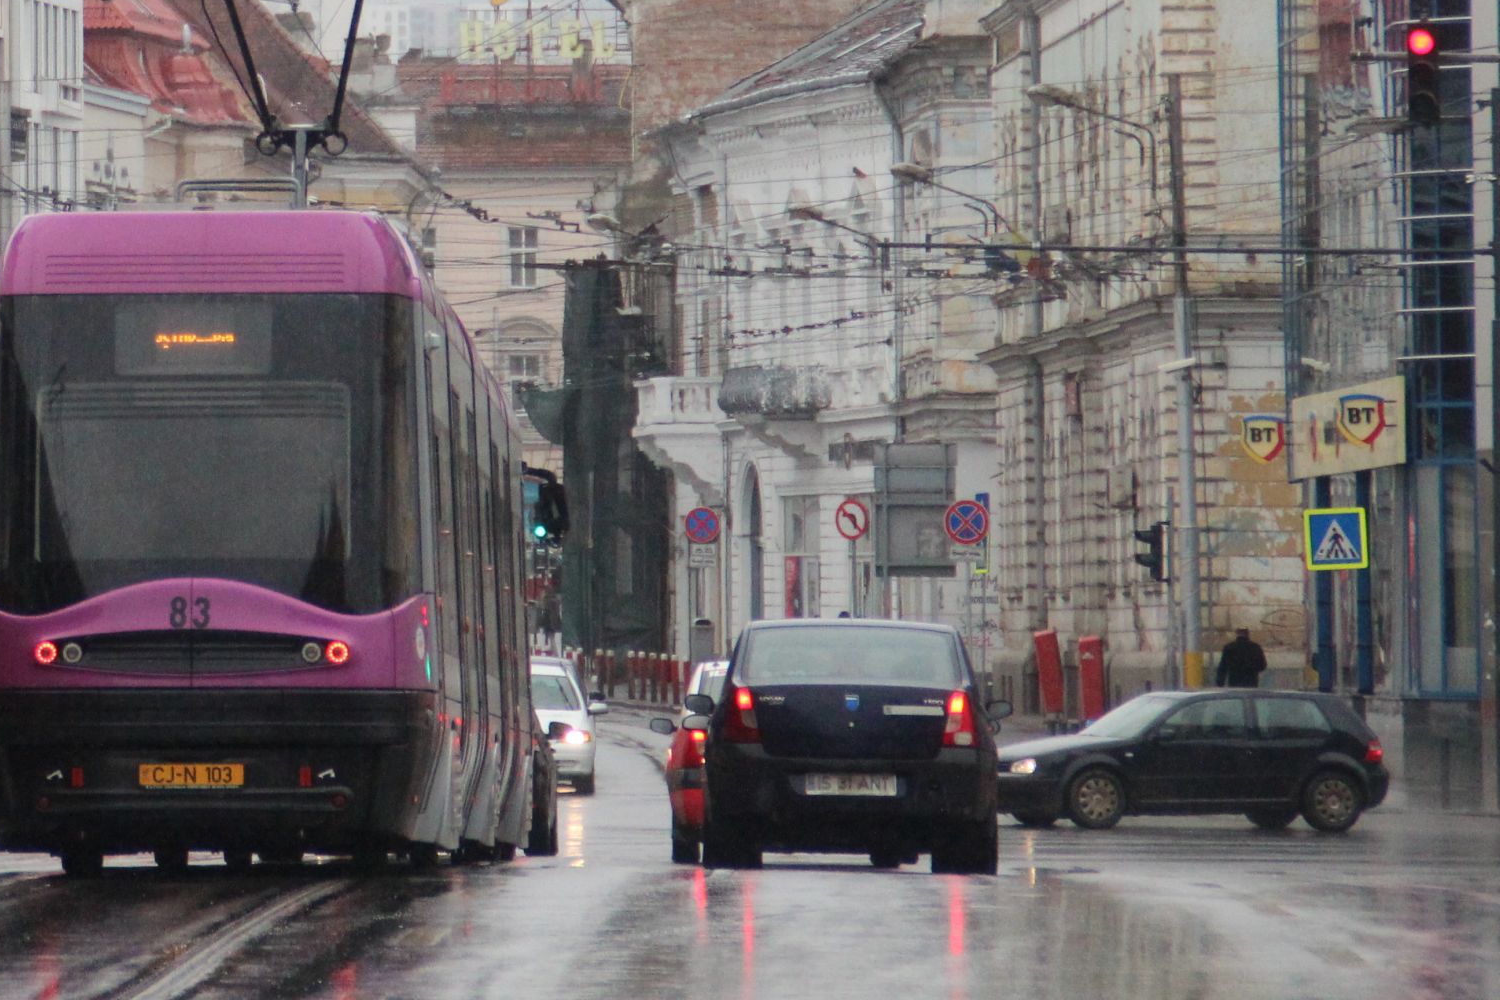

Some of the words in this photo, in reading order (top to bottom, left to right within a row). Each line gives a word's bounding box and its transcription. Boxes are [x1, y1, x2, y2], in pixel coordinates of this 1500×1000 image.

[458, 19, 616, 60] HOTEL
[1348, 407, 1375, 425] BT
[1250, 427, 1276, 444] BT
[169, 596, 211, 629] 83
[152, 766, 197, 783] CJ-N
[205, 766, 233, 783] 103
